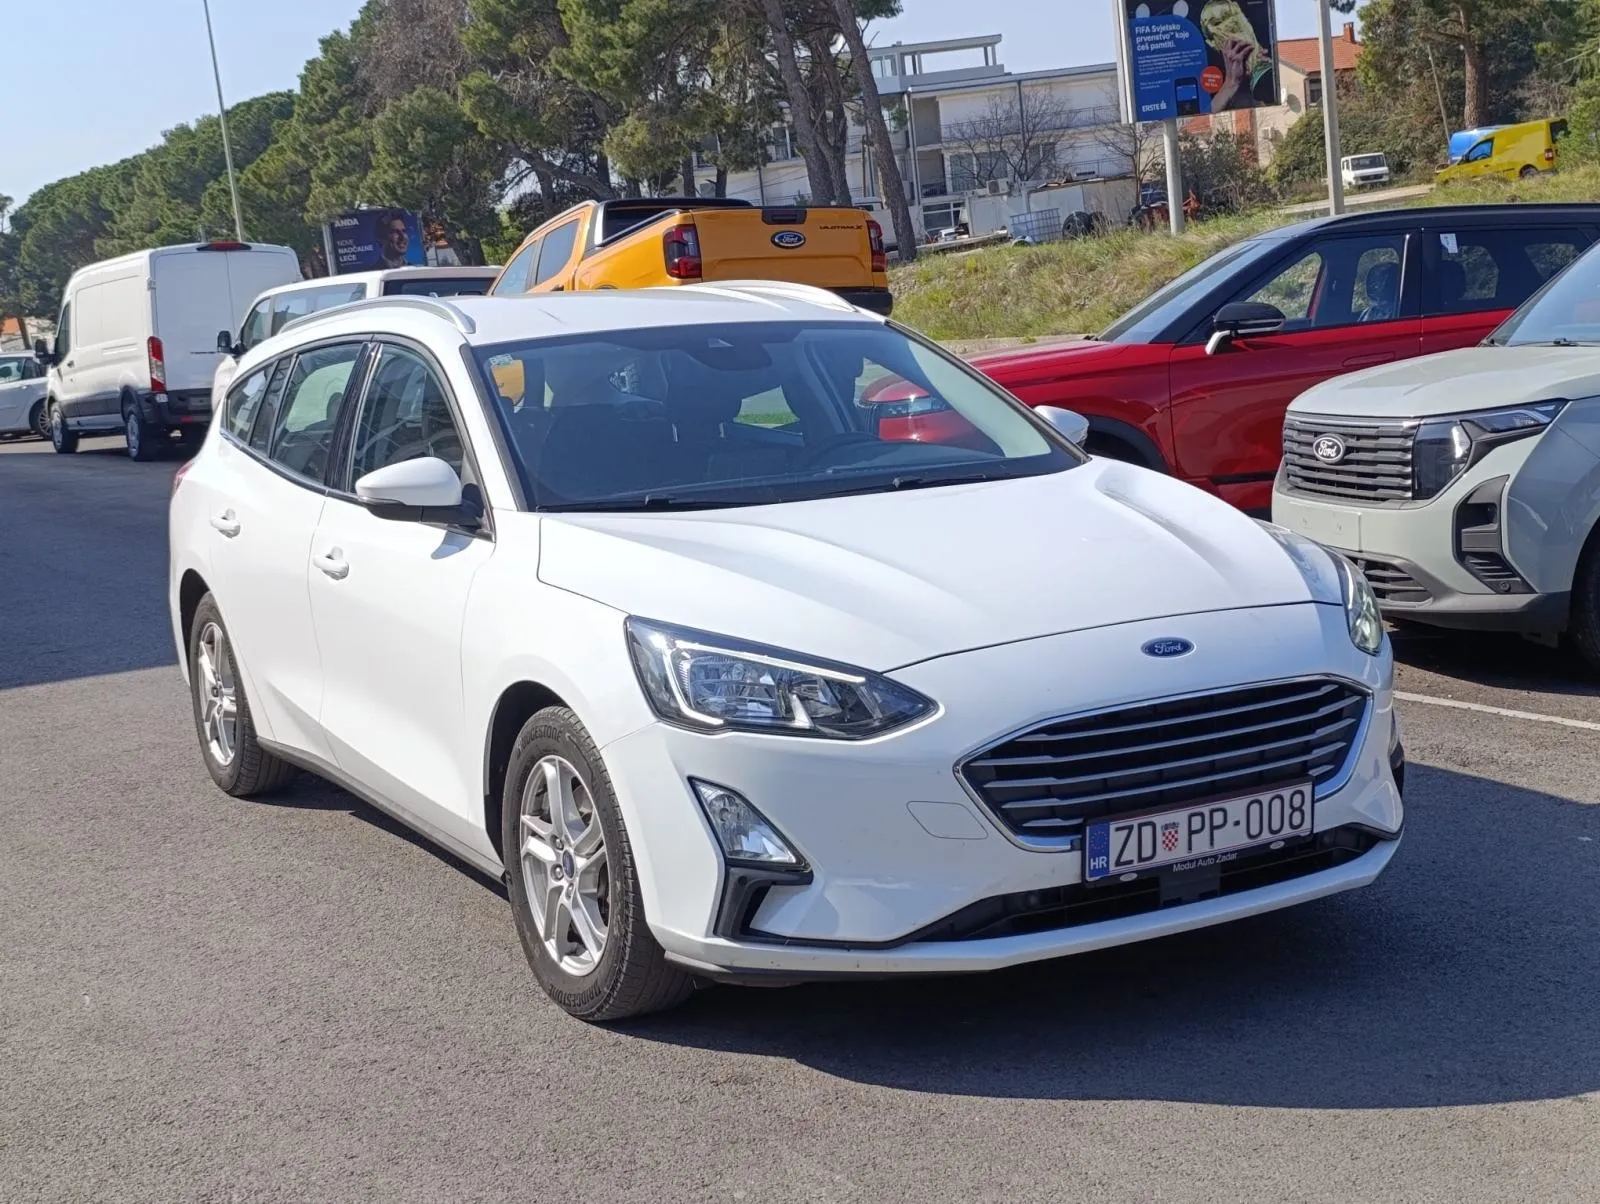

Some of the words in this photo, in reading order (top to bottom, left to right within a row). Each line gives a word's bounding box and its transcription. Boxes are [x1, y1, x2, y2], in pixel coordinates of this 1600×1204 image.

[1135, 26, 1150, 34] FIFA
[1151, 24, 1181, 33] Svjetsko
[1175, 31, 1190, 40] koje
[1150, 40, 1176, 52] pamtiti.
[1142, 104, 1159, 112] ERSTE
[1318, 440, 1338, 457] Ford
[1154, 641, 1184, 654] Ford
[1114, 820, 1157, 867] ZD
[1187, 789, 1305, 853] PP-008
[1089, 855, 1108, 871] HR
[1172, 857, 1196, 873] Modul
[1197, 855, 1215, 868] Auto
[1216, 852, 1238, 865] Zadar
